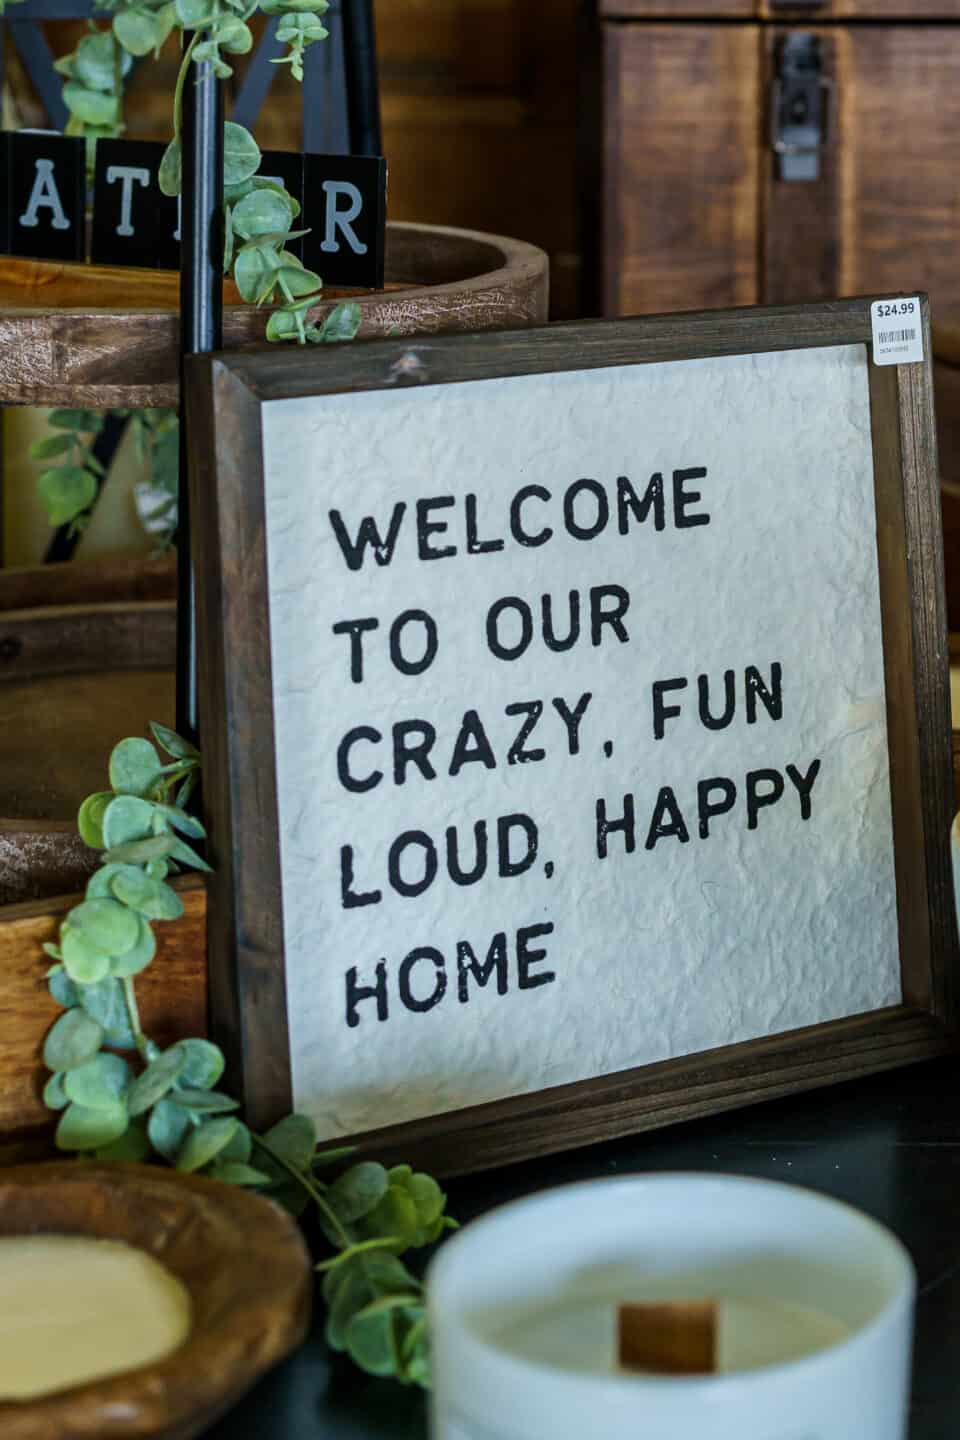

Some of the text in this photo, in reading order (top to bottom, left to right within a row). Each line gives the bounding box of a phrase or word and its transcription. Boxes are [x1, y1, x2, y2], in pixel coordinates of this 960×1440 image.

[877, 303, 915, 317] $24.99
[329, 467, 710, 571] WELCOME
[333, 584, 631, 683] TO OUR
[336, 662, 783, 793] CRAZY, FUN
[340, 760, 821, 909] LOUD, HAPPY
[345, 922, 556, 1027] HOME
